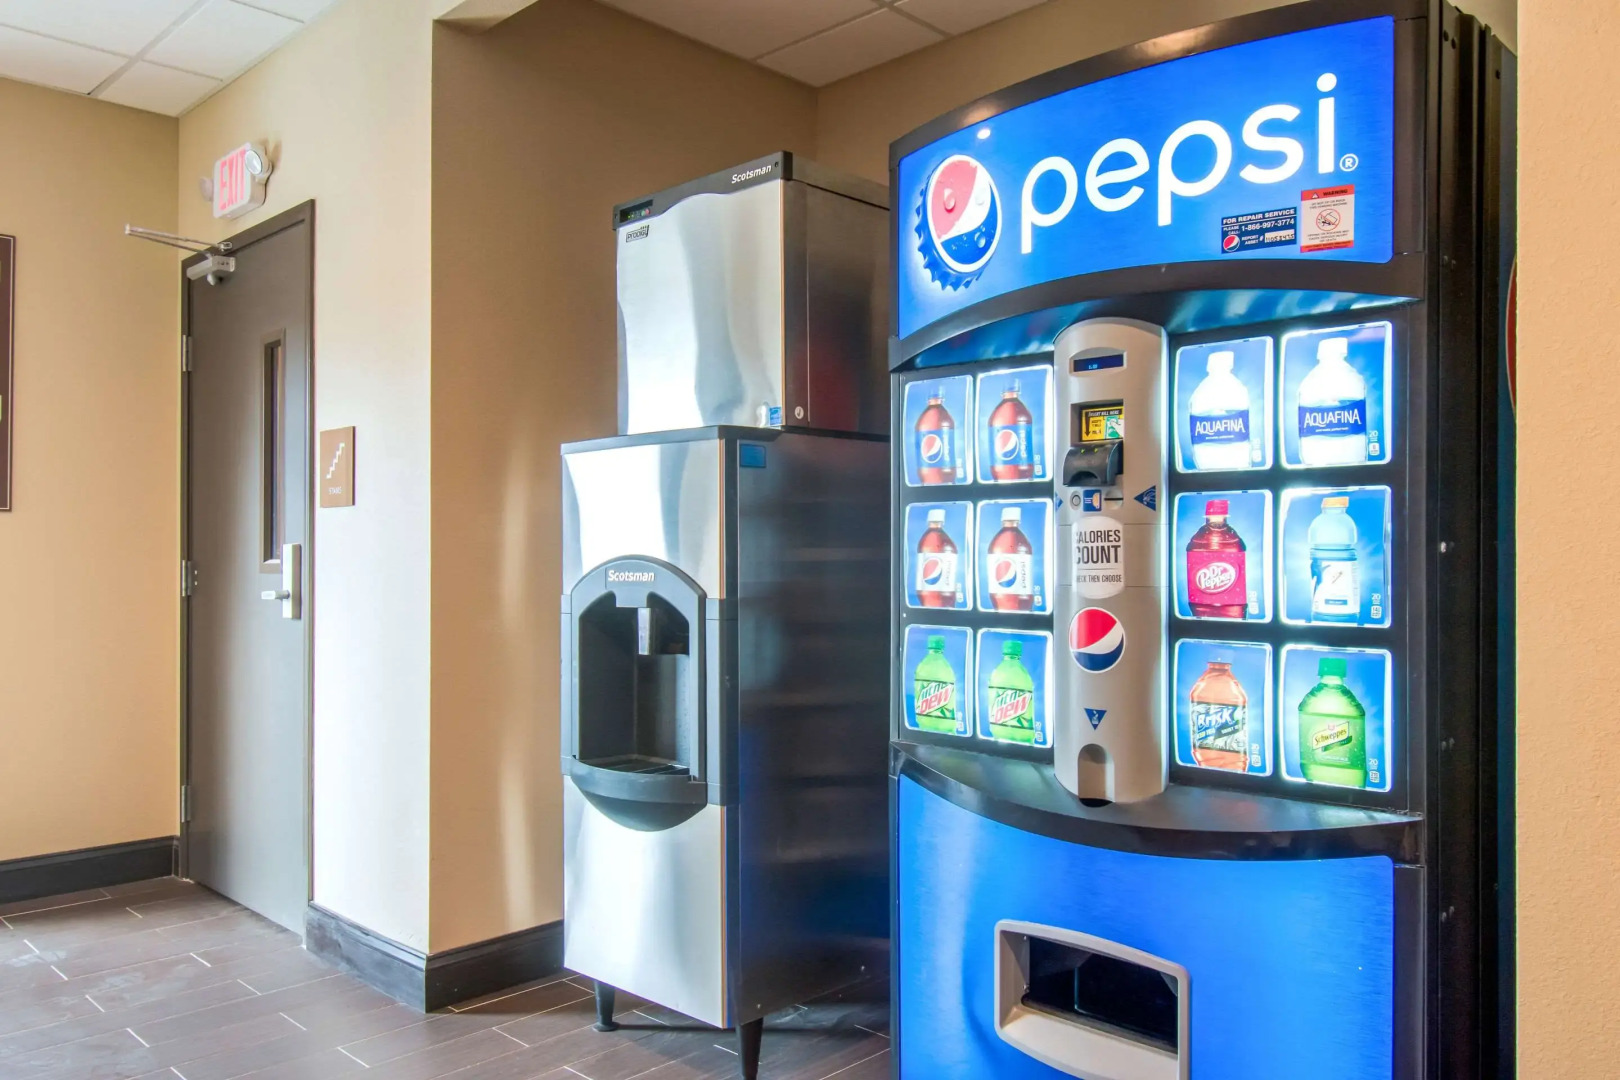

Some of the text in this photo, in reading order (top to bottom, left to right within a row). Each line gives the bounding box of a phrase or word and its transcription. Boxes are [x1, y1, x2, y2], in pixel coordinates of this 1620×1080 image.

[1021, 73, 1338, 255] pepsi
[219, 149, 247, 210] EXIT
[731, 164, 772, 184] Scotsman
[1223, 208, 1295, 225] FOR REPAIR SERVICE
[1241, 218, 1294, 232] 1-866-997-3774
[1194, 417, 1246, 436] AQUAFINA
[1303, 408, 1362, 429] AQUAFINA
[607, 570, 655, 582] Scotsman
[1088, 574, 1100, 583] THEN
[1102, 574, 1122, 583] CHOOSE
[1198, 568, 1233, 590] Pepper
[1209, 565, 1224, 578] Dr
[1314, 729, 1347, 746] Schweppes
